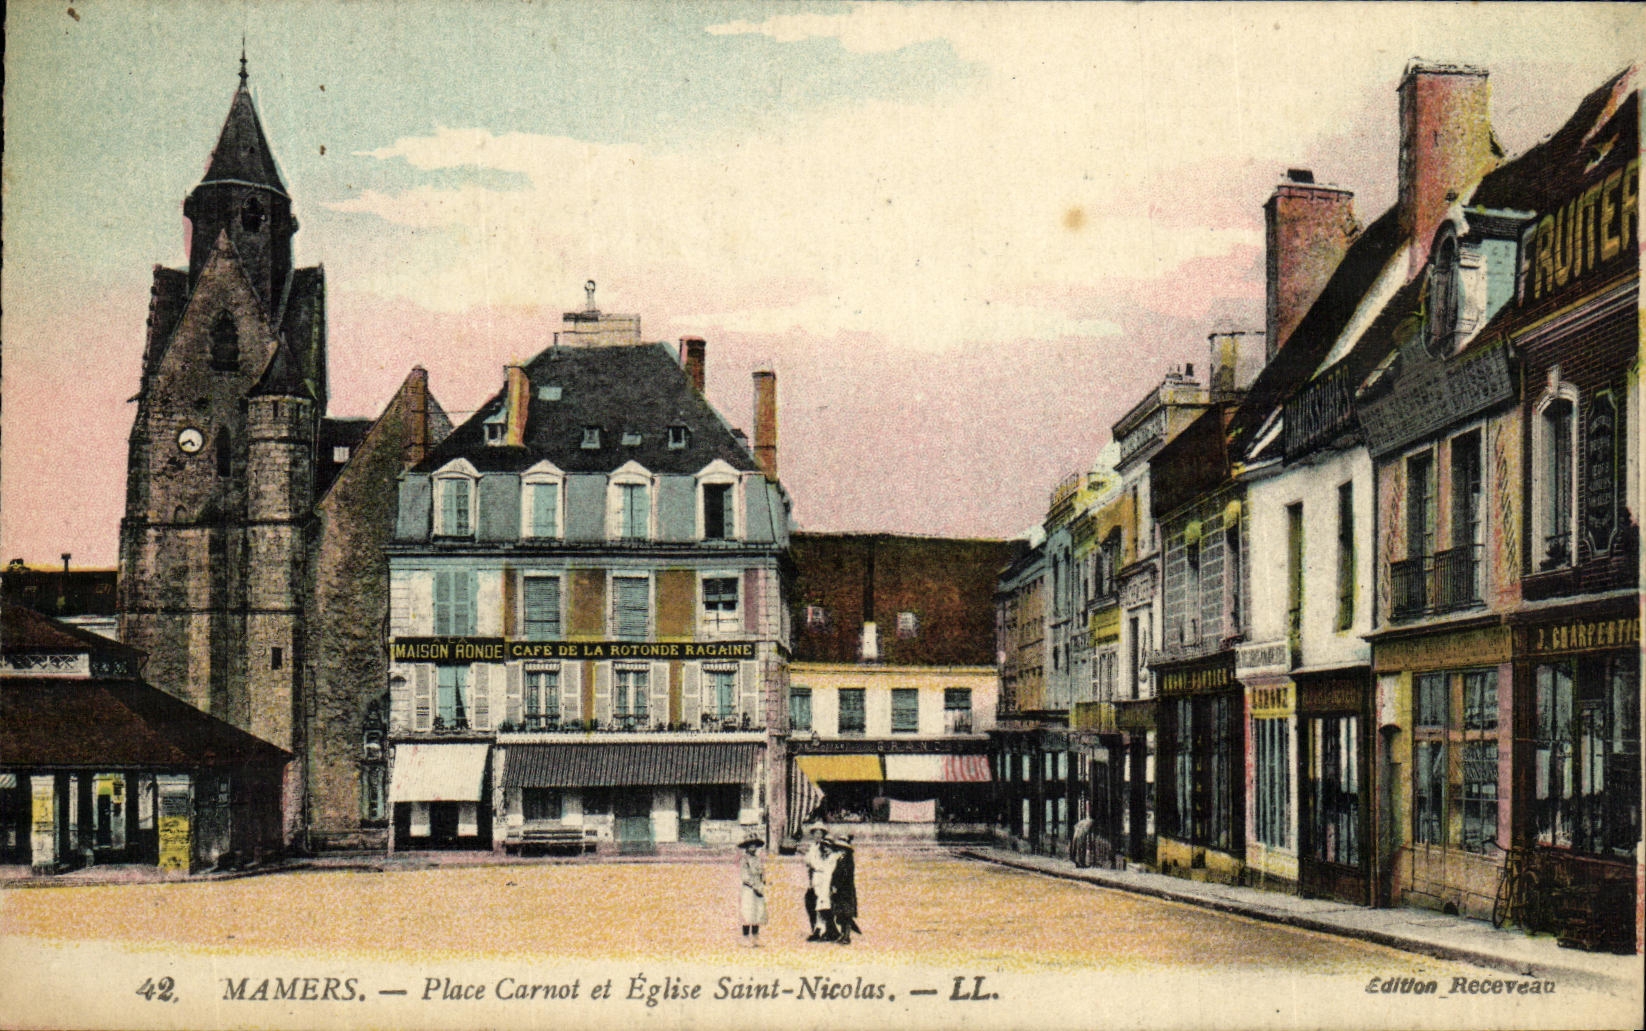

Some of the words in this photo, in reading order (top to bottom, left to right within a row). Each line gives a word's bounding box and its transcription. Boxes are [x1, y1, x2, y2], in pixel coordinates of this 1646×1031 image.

[395, 643, 449, 659] MAISON
[455, 643, 504, 659] RONDE
[558, 645, 578, 656] DE
[583, 645, 604, 656] LA
[610, 644, 679, 656] ROTONDE
[685, 644, 753, 656] RAGAINE
